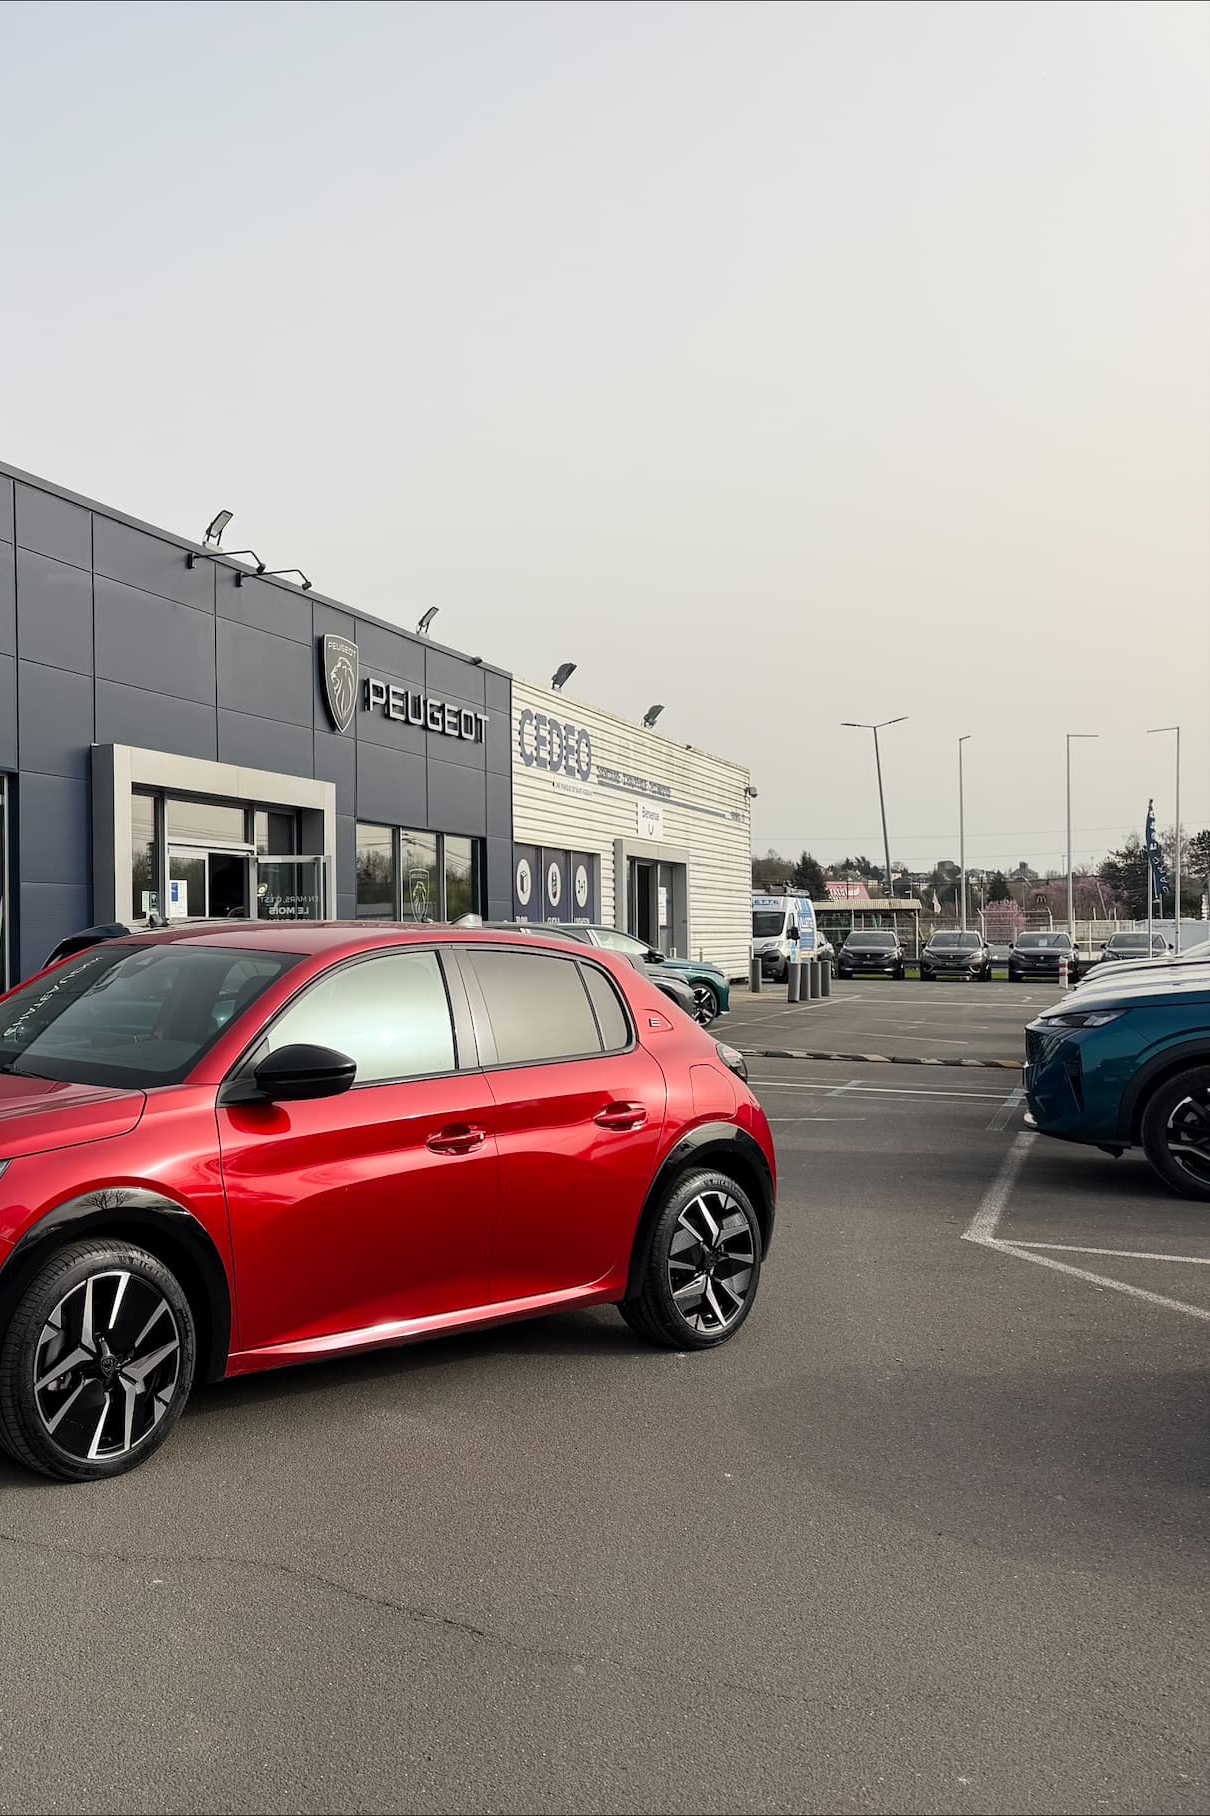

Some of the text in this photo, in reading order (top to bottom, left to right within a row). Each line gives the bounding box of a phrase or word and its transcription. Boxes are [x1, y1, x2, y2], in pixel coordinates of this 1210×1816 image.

[327, 641, 357, 658] PEUGEOT
[368, 677, 490, 744] PEUGEOT
[518, 708, 592, 782] CEDEO
